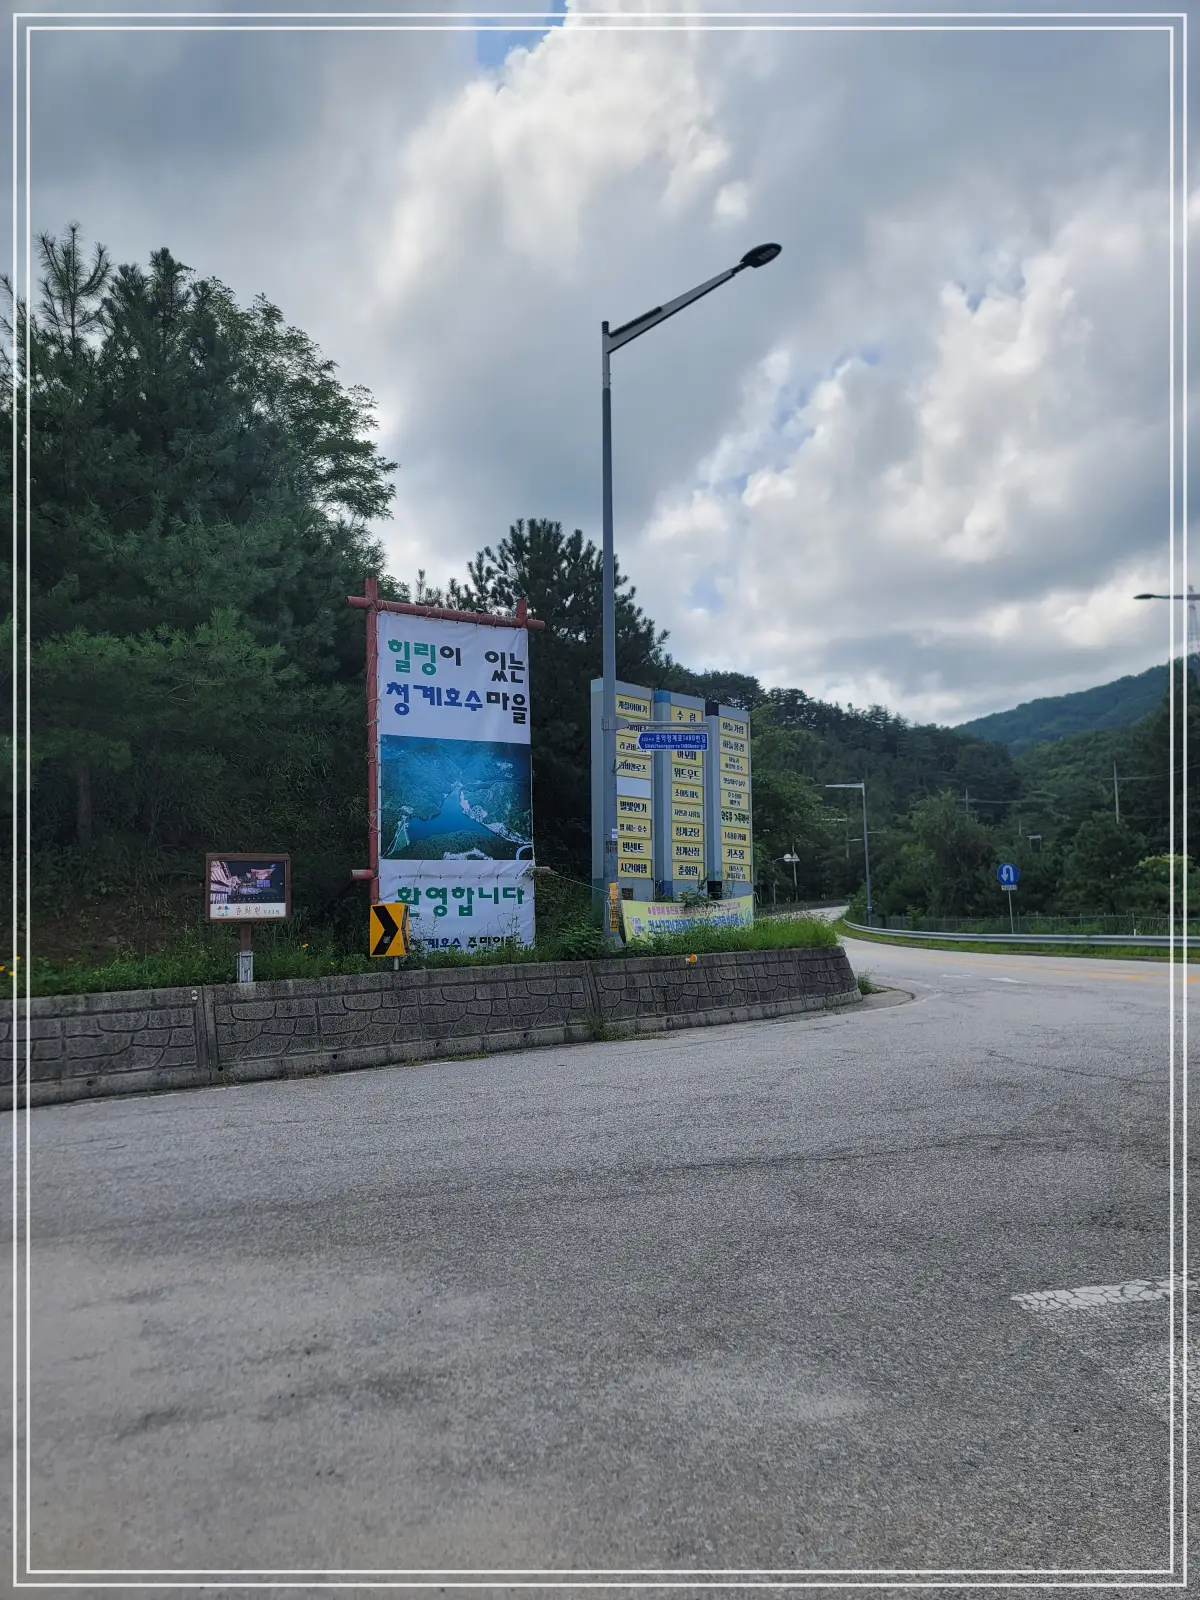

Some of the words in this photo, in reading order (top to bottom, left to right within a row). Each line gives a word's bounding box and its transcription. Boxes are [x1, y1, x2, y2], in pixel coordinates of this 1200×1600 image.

[388, 639, 461, 675] 힐링이
[484, 651, 525, 683] 있는
[386, 682, 527, 724] 청계호수마을
[620, 801, 648, 813] 별빛연가
[622, 841, 645, 853] 빈센트
[620, 862, 648, 874] 시간여행
[394, 886, 525, 917] 환영합니다
